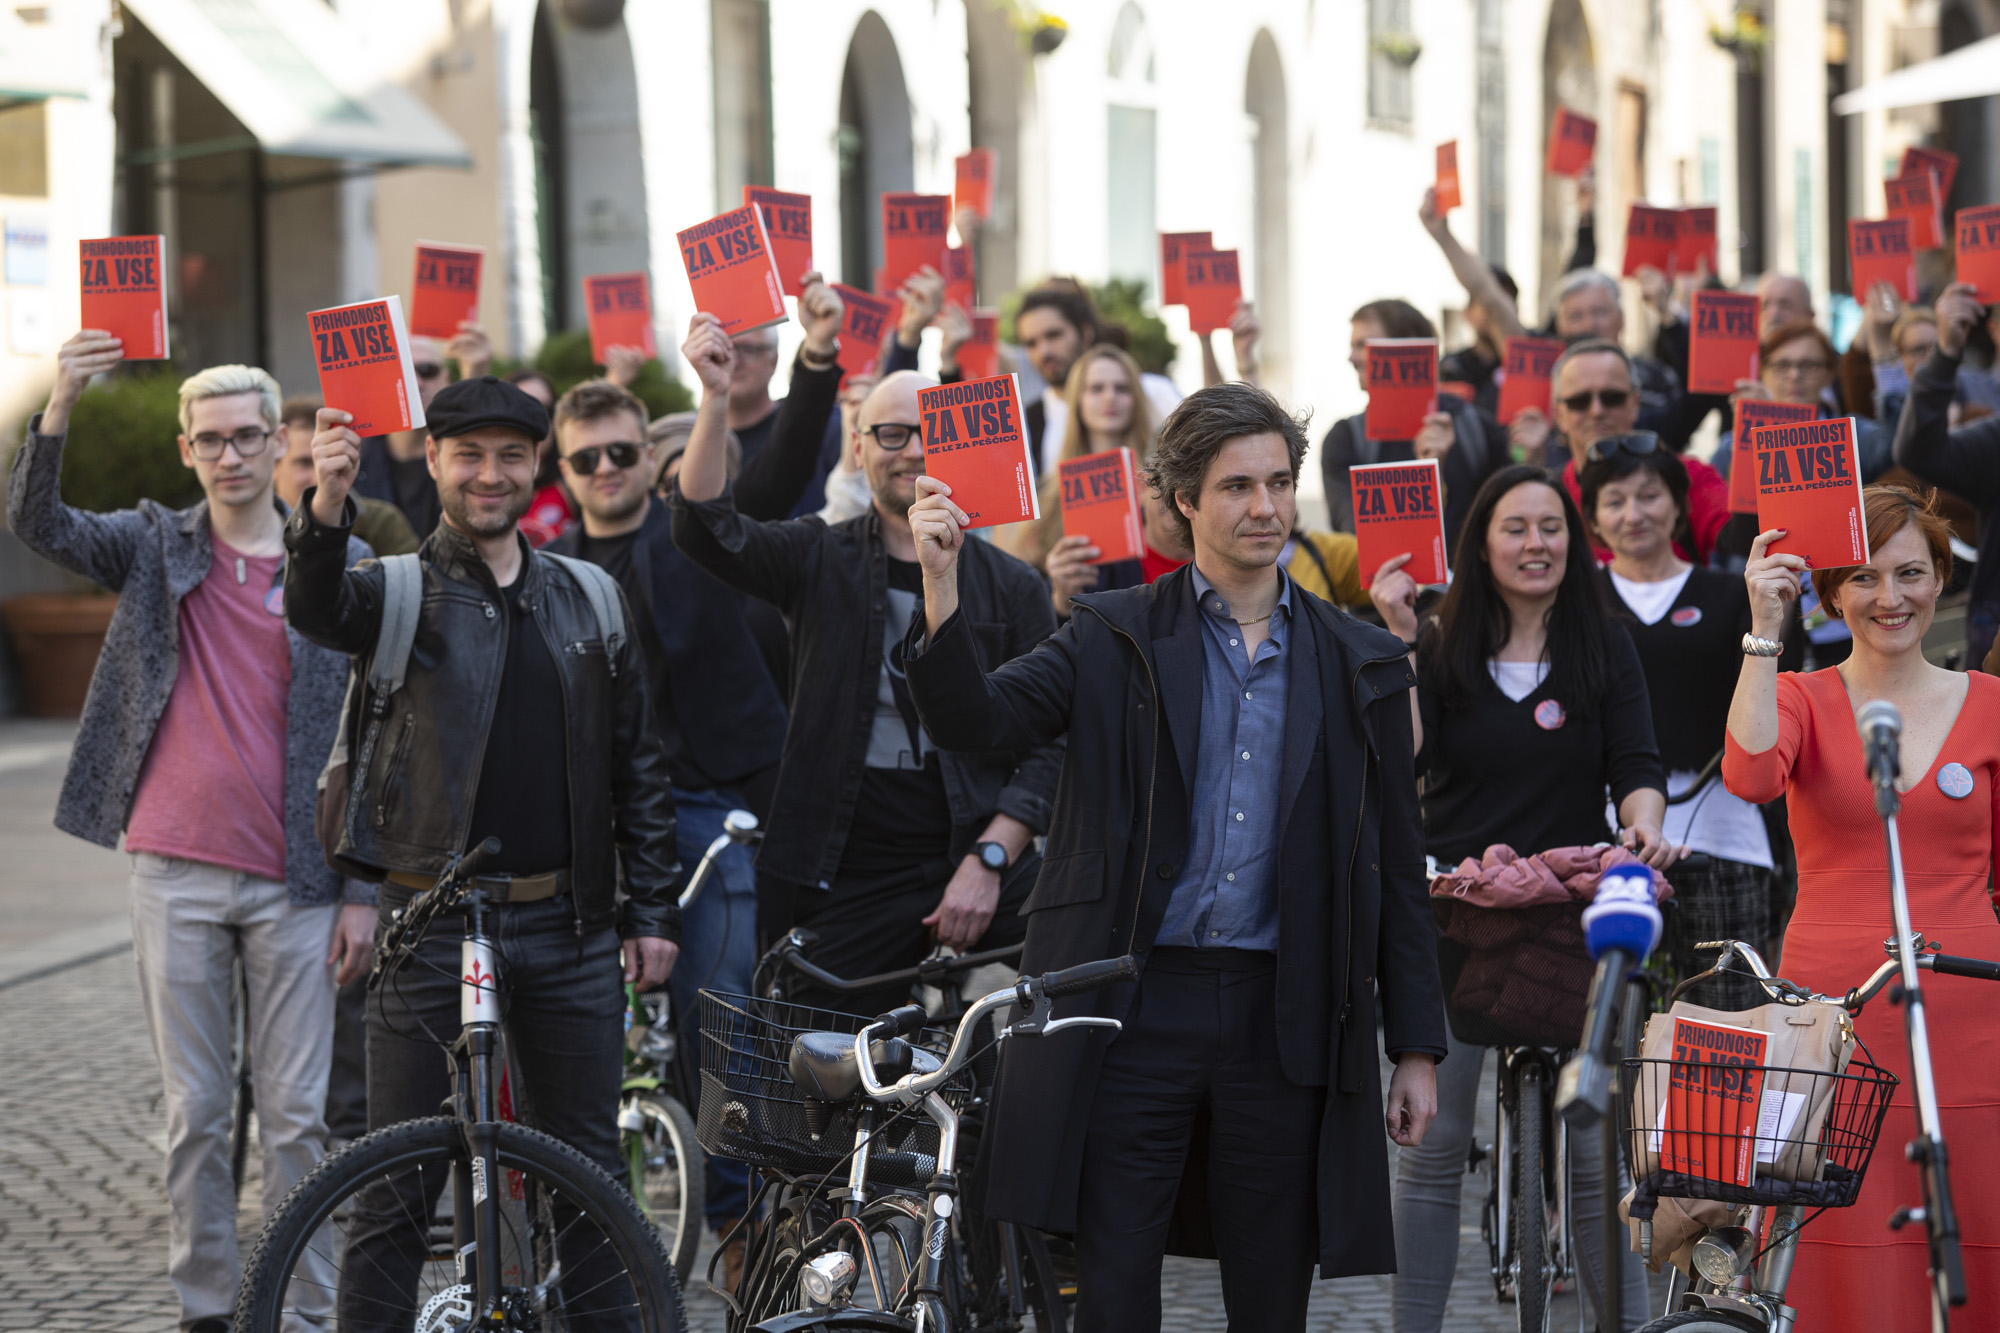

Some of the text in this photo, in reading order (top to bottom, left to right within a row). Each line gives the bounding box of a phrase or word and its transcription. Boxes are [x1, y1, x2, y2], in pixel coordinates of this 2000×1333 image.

[680, 207, 753, 246] PRIHODNOST
[82, 240, 155, 257] PRIHODNOST
[684, 241, 715, 273] ZA
[83, 259, 109, 286] ZA
[312, 305, 387, 332] PRIHODNOST
[316, 331, 349, 364] ZA
[921, 378, 1011, 411] PRIHODNOST
[923, 399, 1018, 446] ZA VSE,
[1742, 403, 1812, 421] PRIHODNOST
[927, 434, 1018, 455] NE LE ZA PEŠČICO
[1756, 423, 1846, 450] PRIHODNOST
[1355, 468, 1432, 487] PRIHODNOST
[1758, 444, 1852, 486] ZA VSE,
[1064, 478, 1085, 502] ZA
[1760, 487, 1773, 495] NE
[1775, 485, 1787, 493] LE
[1805, 479, 1853, 491] PEŠČICO
[1357, 487, 1387, 516] ZA
[1677, 1023, 1762, 1057] PRIHODNOST
[1673, 1044, 1702, 1083] ZA
